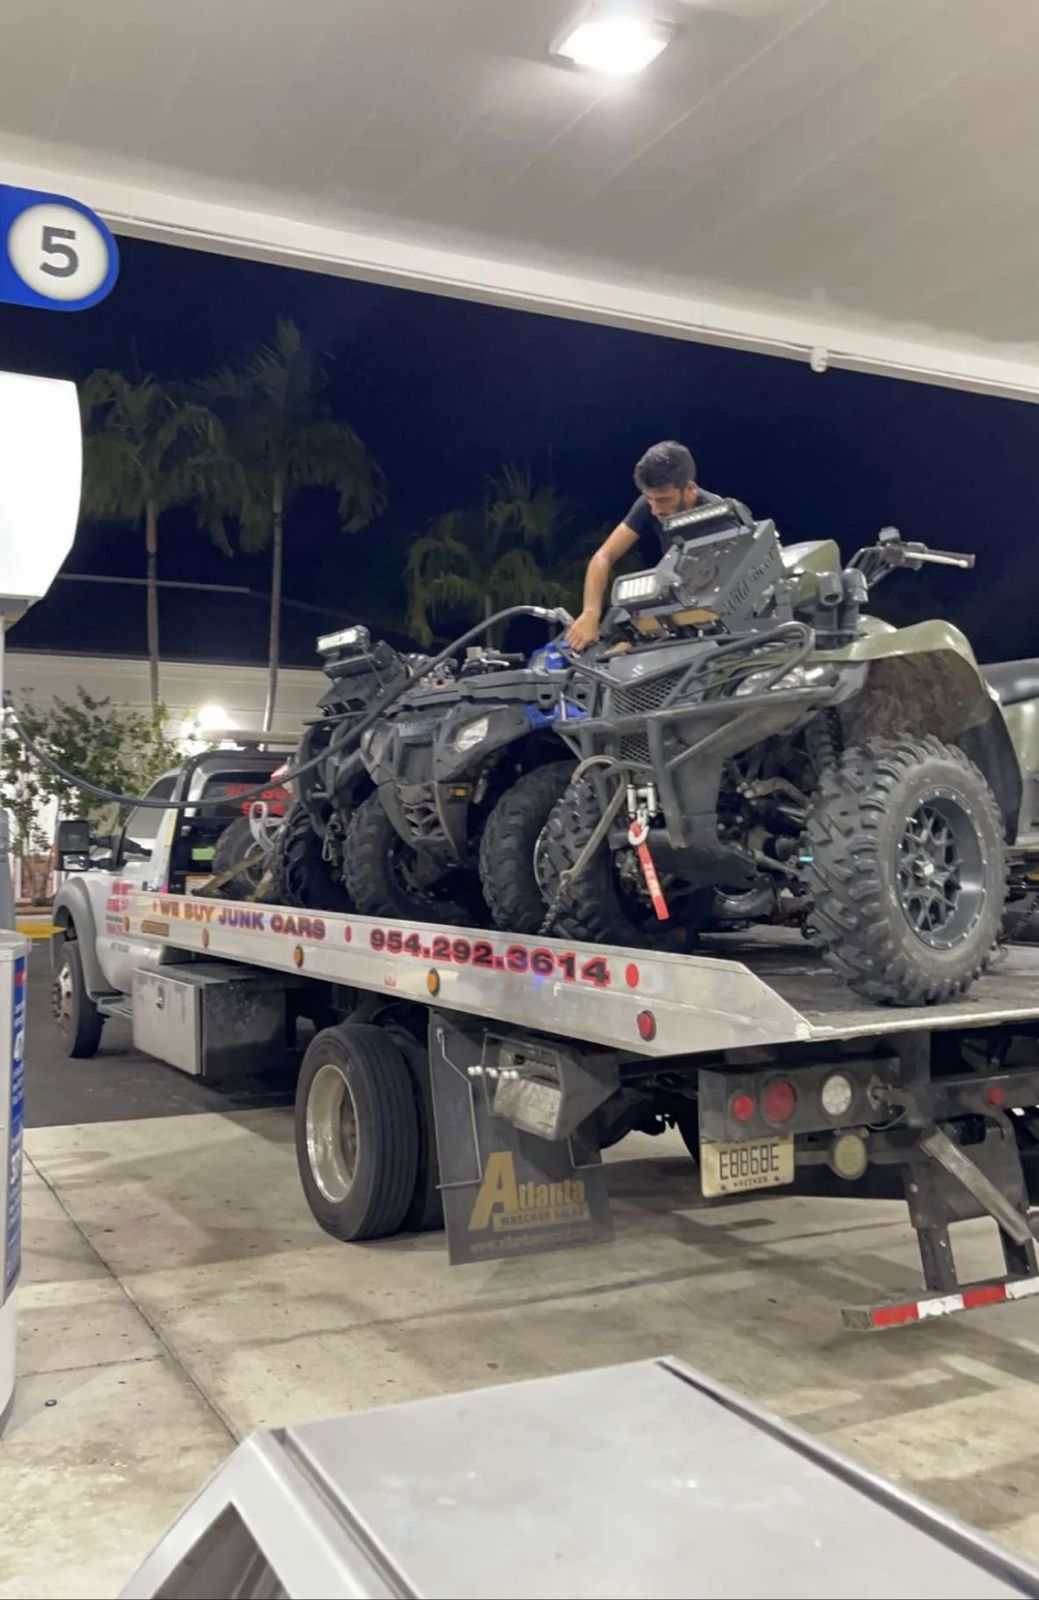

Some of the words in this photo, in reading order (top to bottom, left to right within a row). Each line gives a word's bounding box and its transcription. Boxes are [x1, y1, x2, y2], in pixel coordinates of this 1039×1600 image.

[39, 225, 79, 278] 5
[159, 898, 179, 917] WE
[184, 902, 214, 922] BUY
[217, 907, 265, 931] JUNK
[269, 913, 326, 940] CARS
[370, 927, 611, 987] 954.292.3614
[468, 1151, 585, 1231] Atlanta
